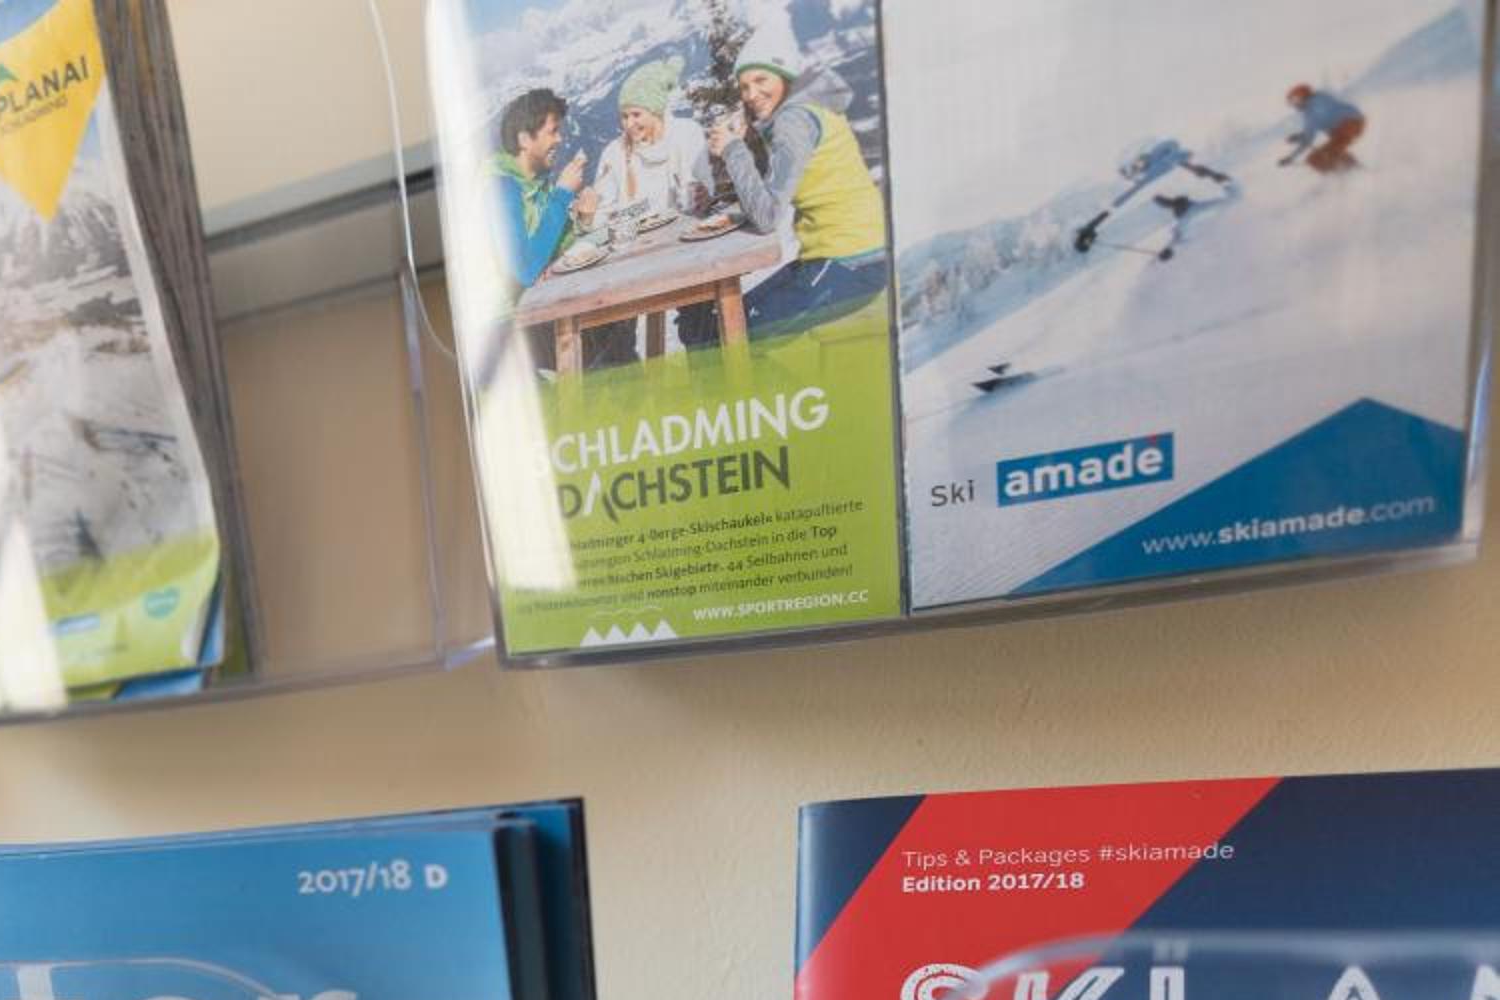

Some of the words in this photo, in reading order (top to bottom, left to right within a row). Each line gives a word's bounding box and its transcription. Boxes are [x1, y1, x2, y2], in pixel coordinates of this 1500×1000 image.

[557, 446, 790, 524] DACHSTEIN
[931, 479, 975, 507] Ski
[811, 523, 838, 542] Top
[1141, 494, 1436, 555] www.skiamade.com
[902, 850, 948, 871] Tips
[954, 850, 971, 867] &
[979, 846, 1091, 868] Packages
[1100, 841, 1236, 862] #skiamade
[297, 859, 412, 897] 2017/18
[425, 863, 449, 889] D
[902, 874, 981, 894] Edition
[987, 871, 1086, 890] 2017/18
